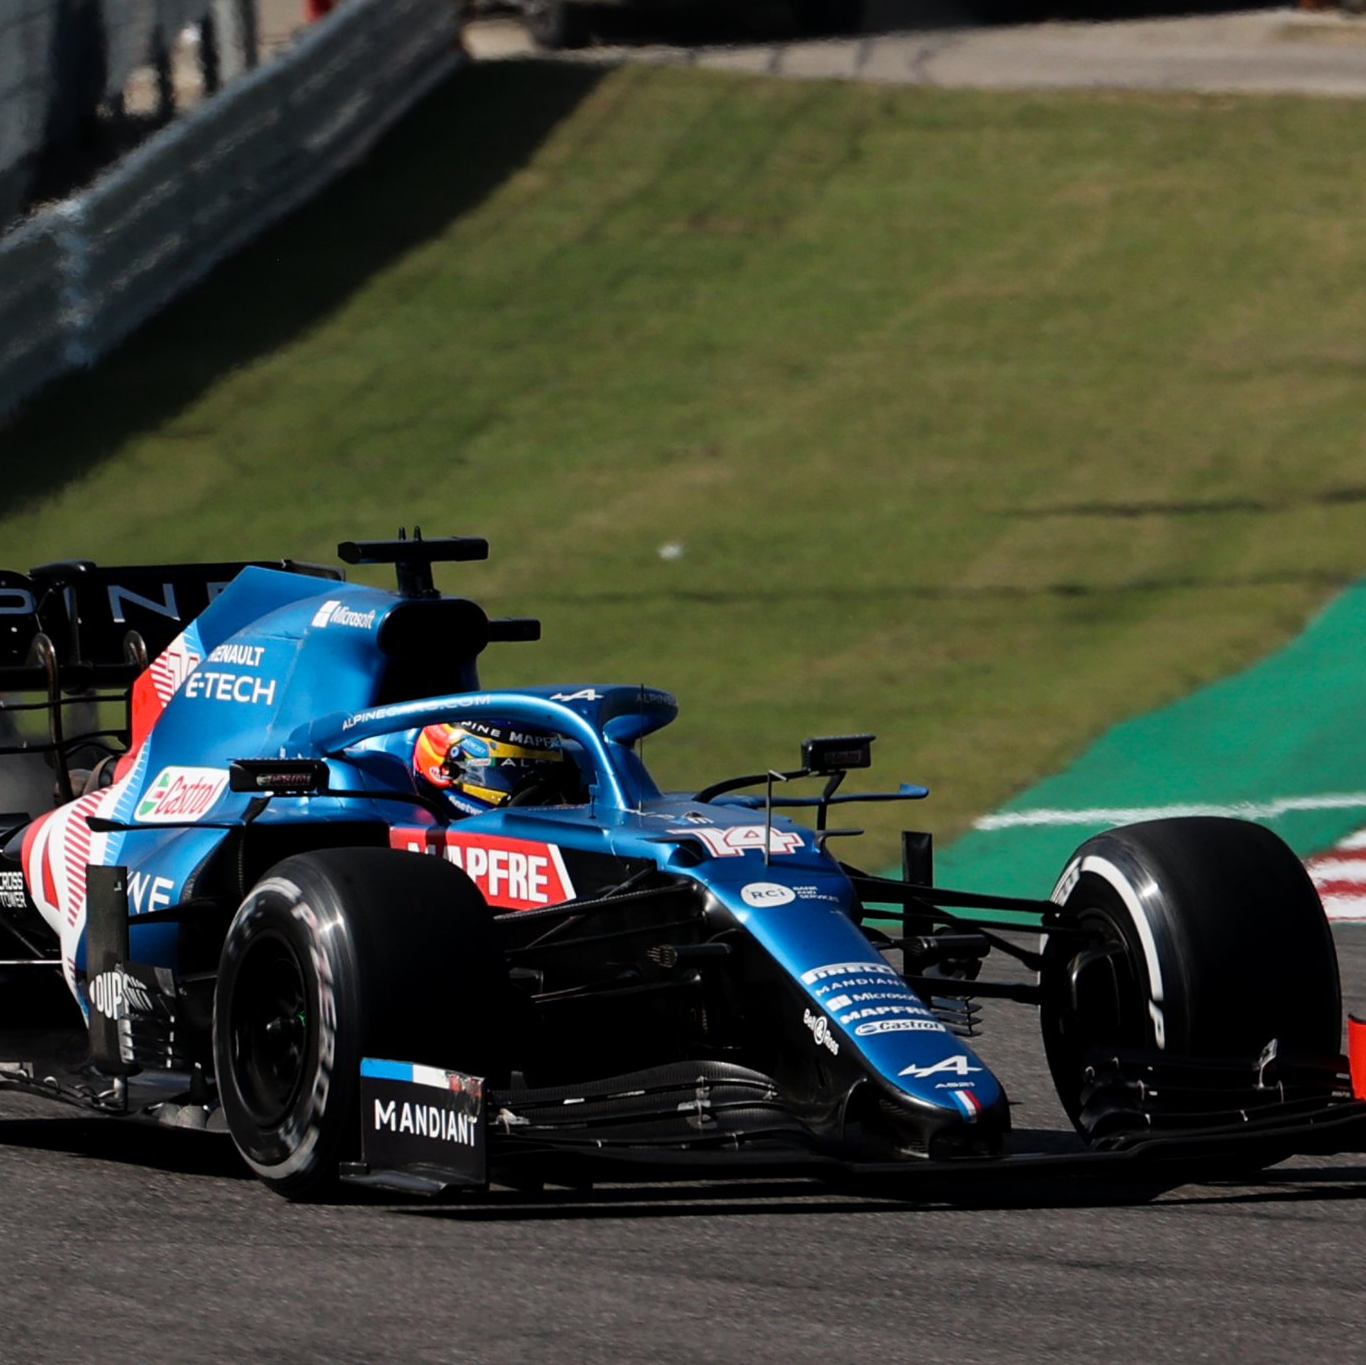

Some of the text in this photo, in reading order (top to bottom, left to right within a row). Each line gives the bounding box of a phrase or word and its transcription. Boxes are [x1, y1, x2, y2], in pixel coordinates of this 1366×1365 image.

[329, 604, 377, 630] Microsoft
[207, 644, 265, 667] RENAULT
[154, 775, 225, 815] Castrol
[665, 824, 806, 859] 14
[374, 1098, 477, 1148] MANDIANT
